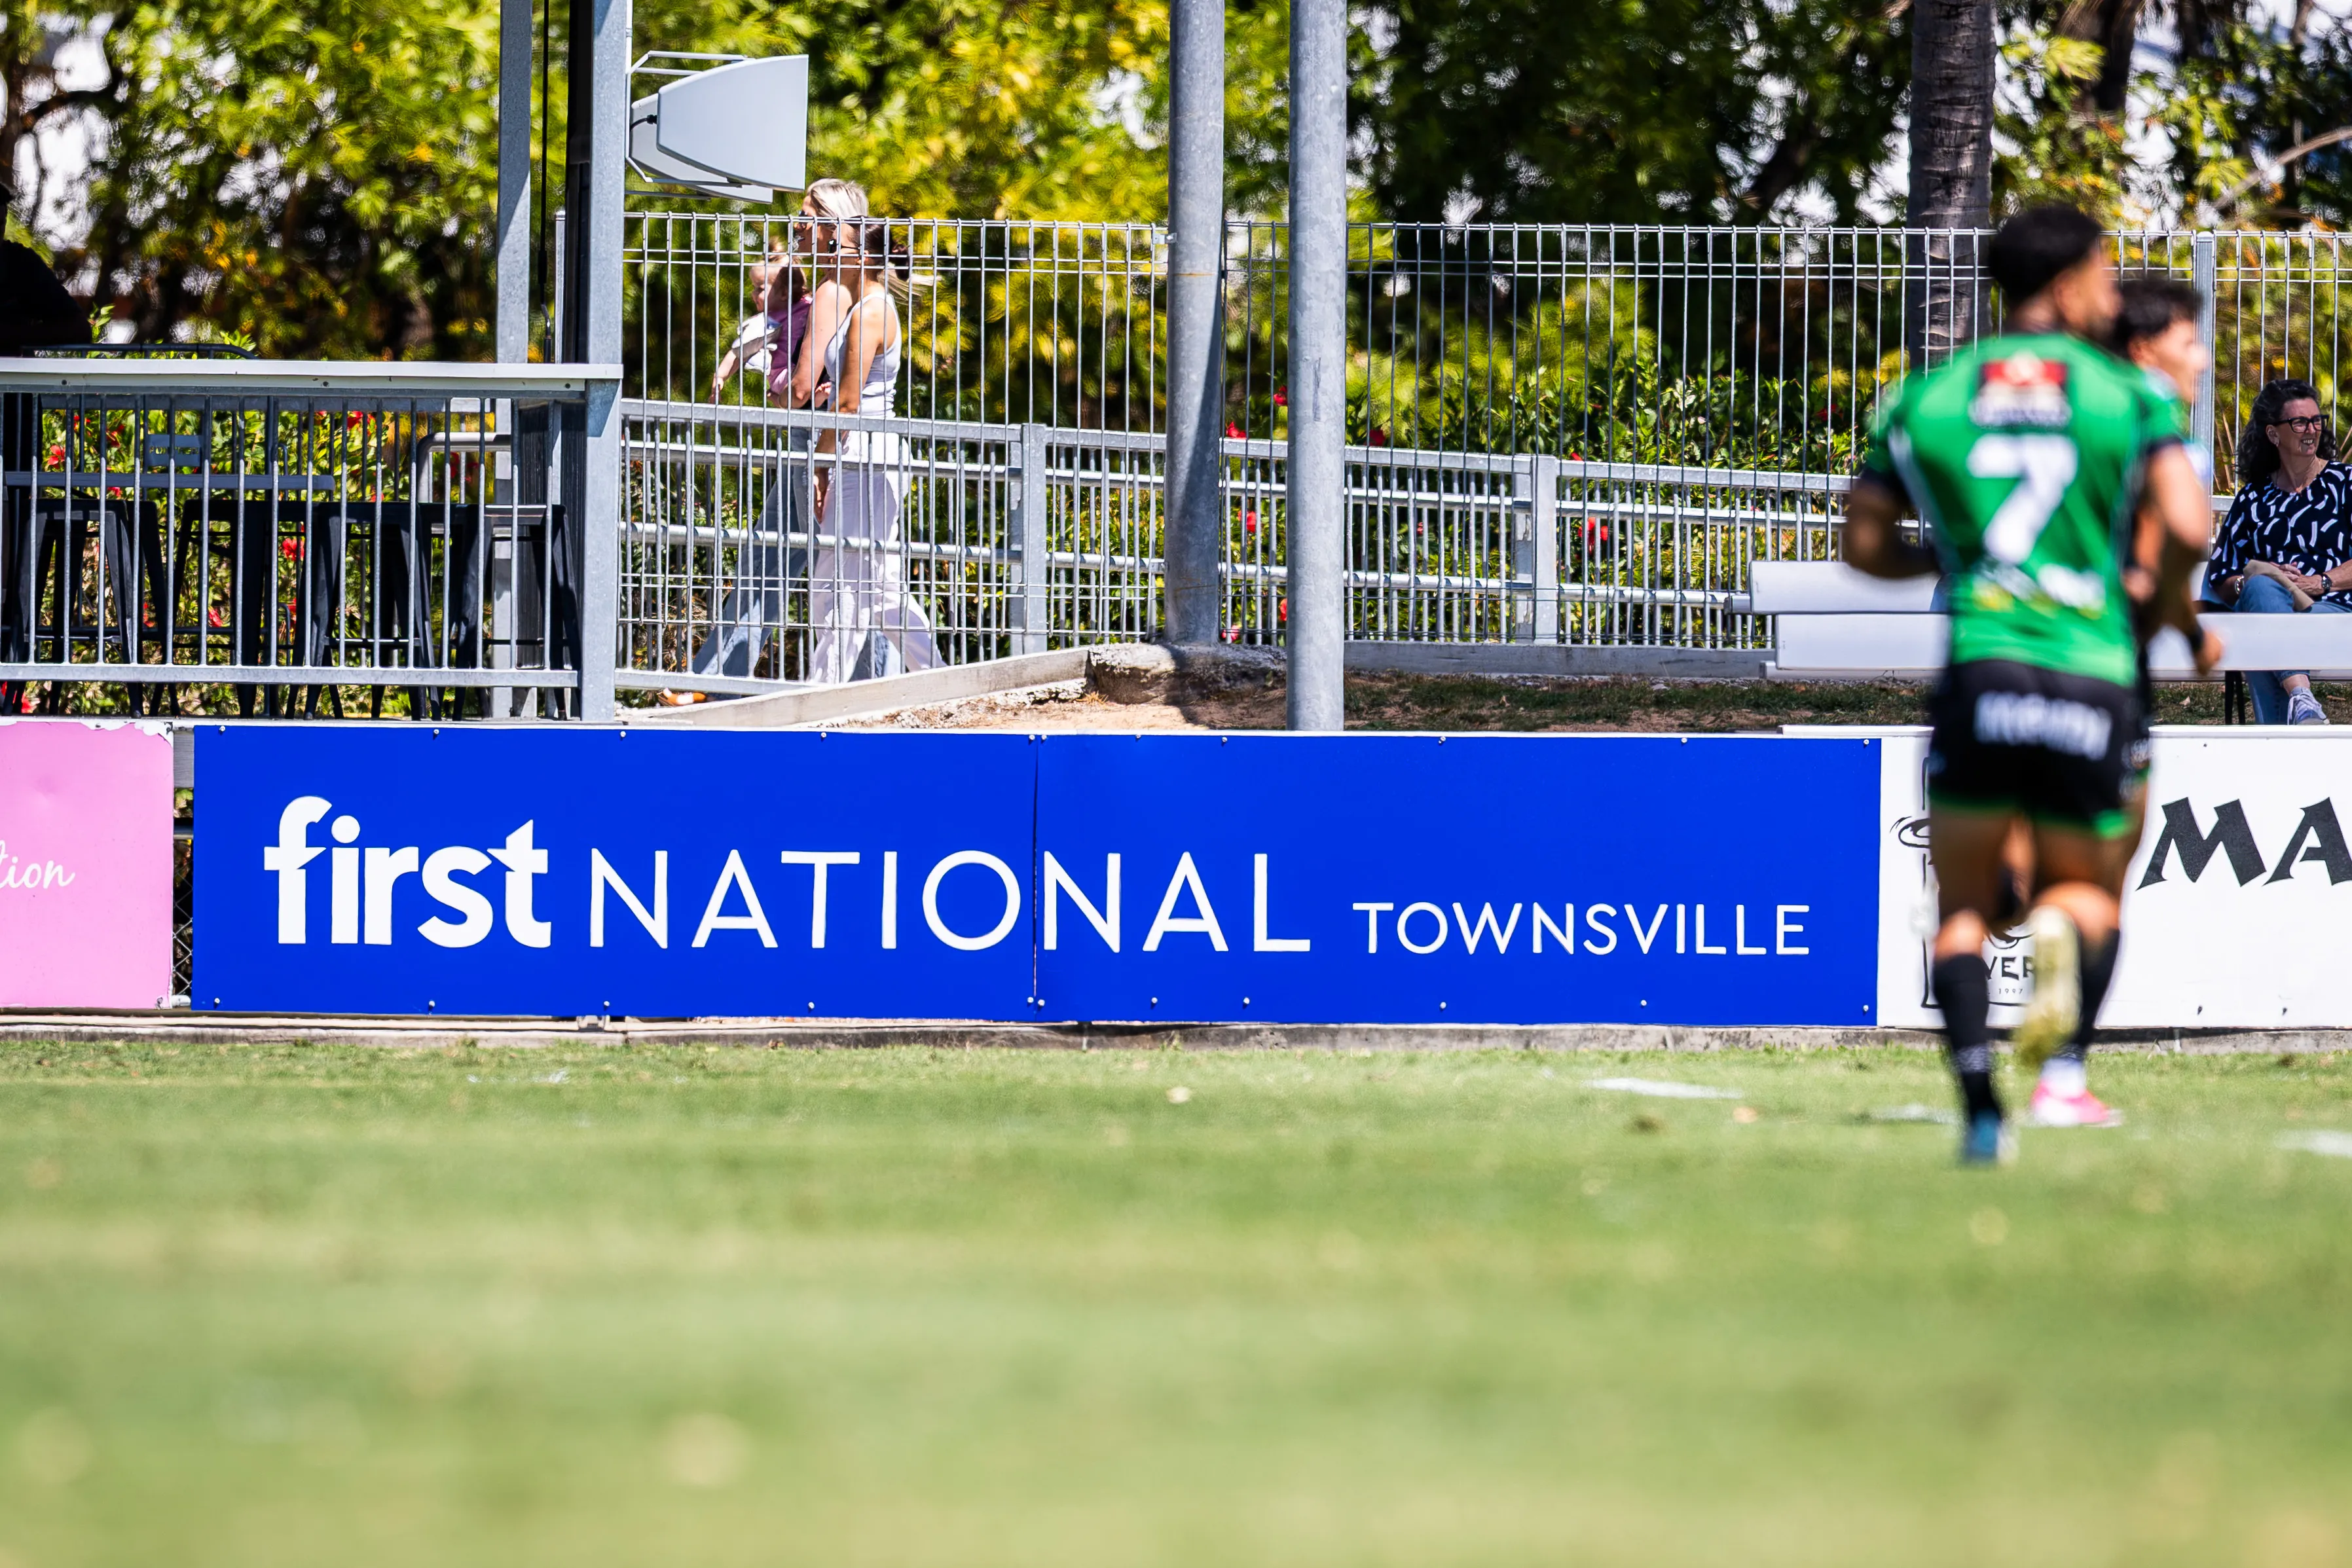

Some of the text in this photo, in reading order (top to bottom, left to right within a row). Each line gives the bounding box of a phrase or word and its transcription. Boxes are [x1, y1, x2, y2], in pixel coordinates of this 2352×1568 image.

[1967, 433, 2078, 565] 7
[264, 795, 1810, 956] first NATIONAL TOWNSVILLE
[2136, 796, 2352, 891] MA
[1981, 955, 2035, 981] VER
